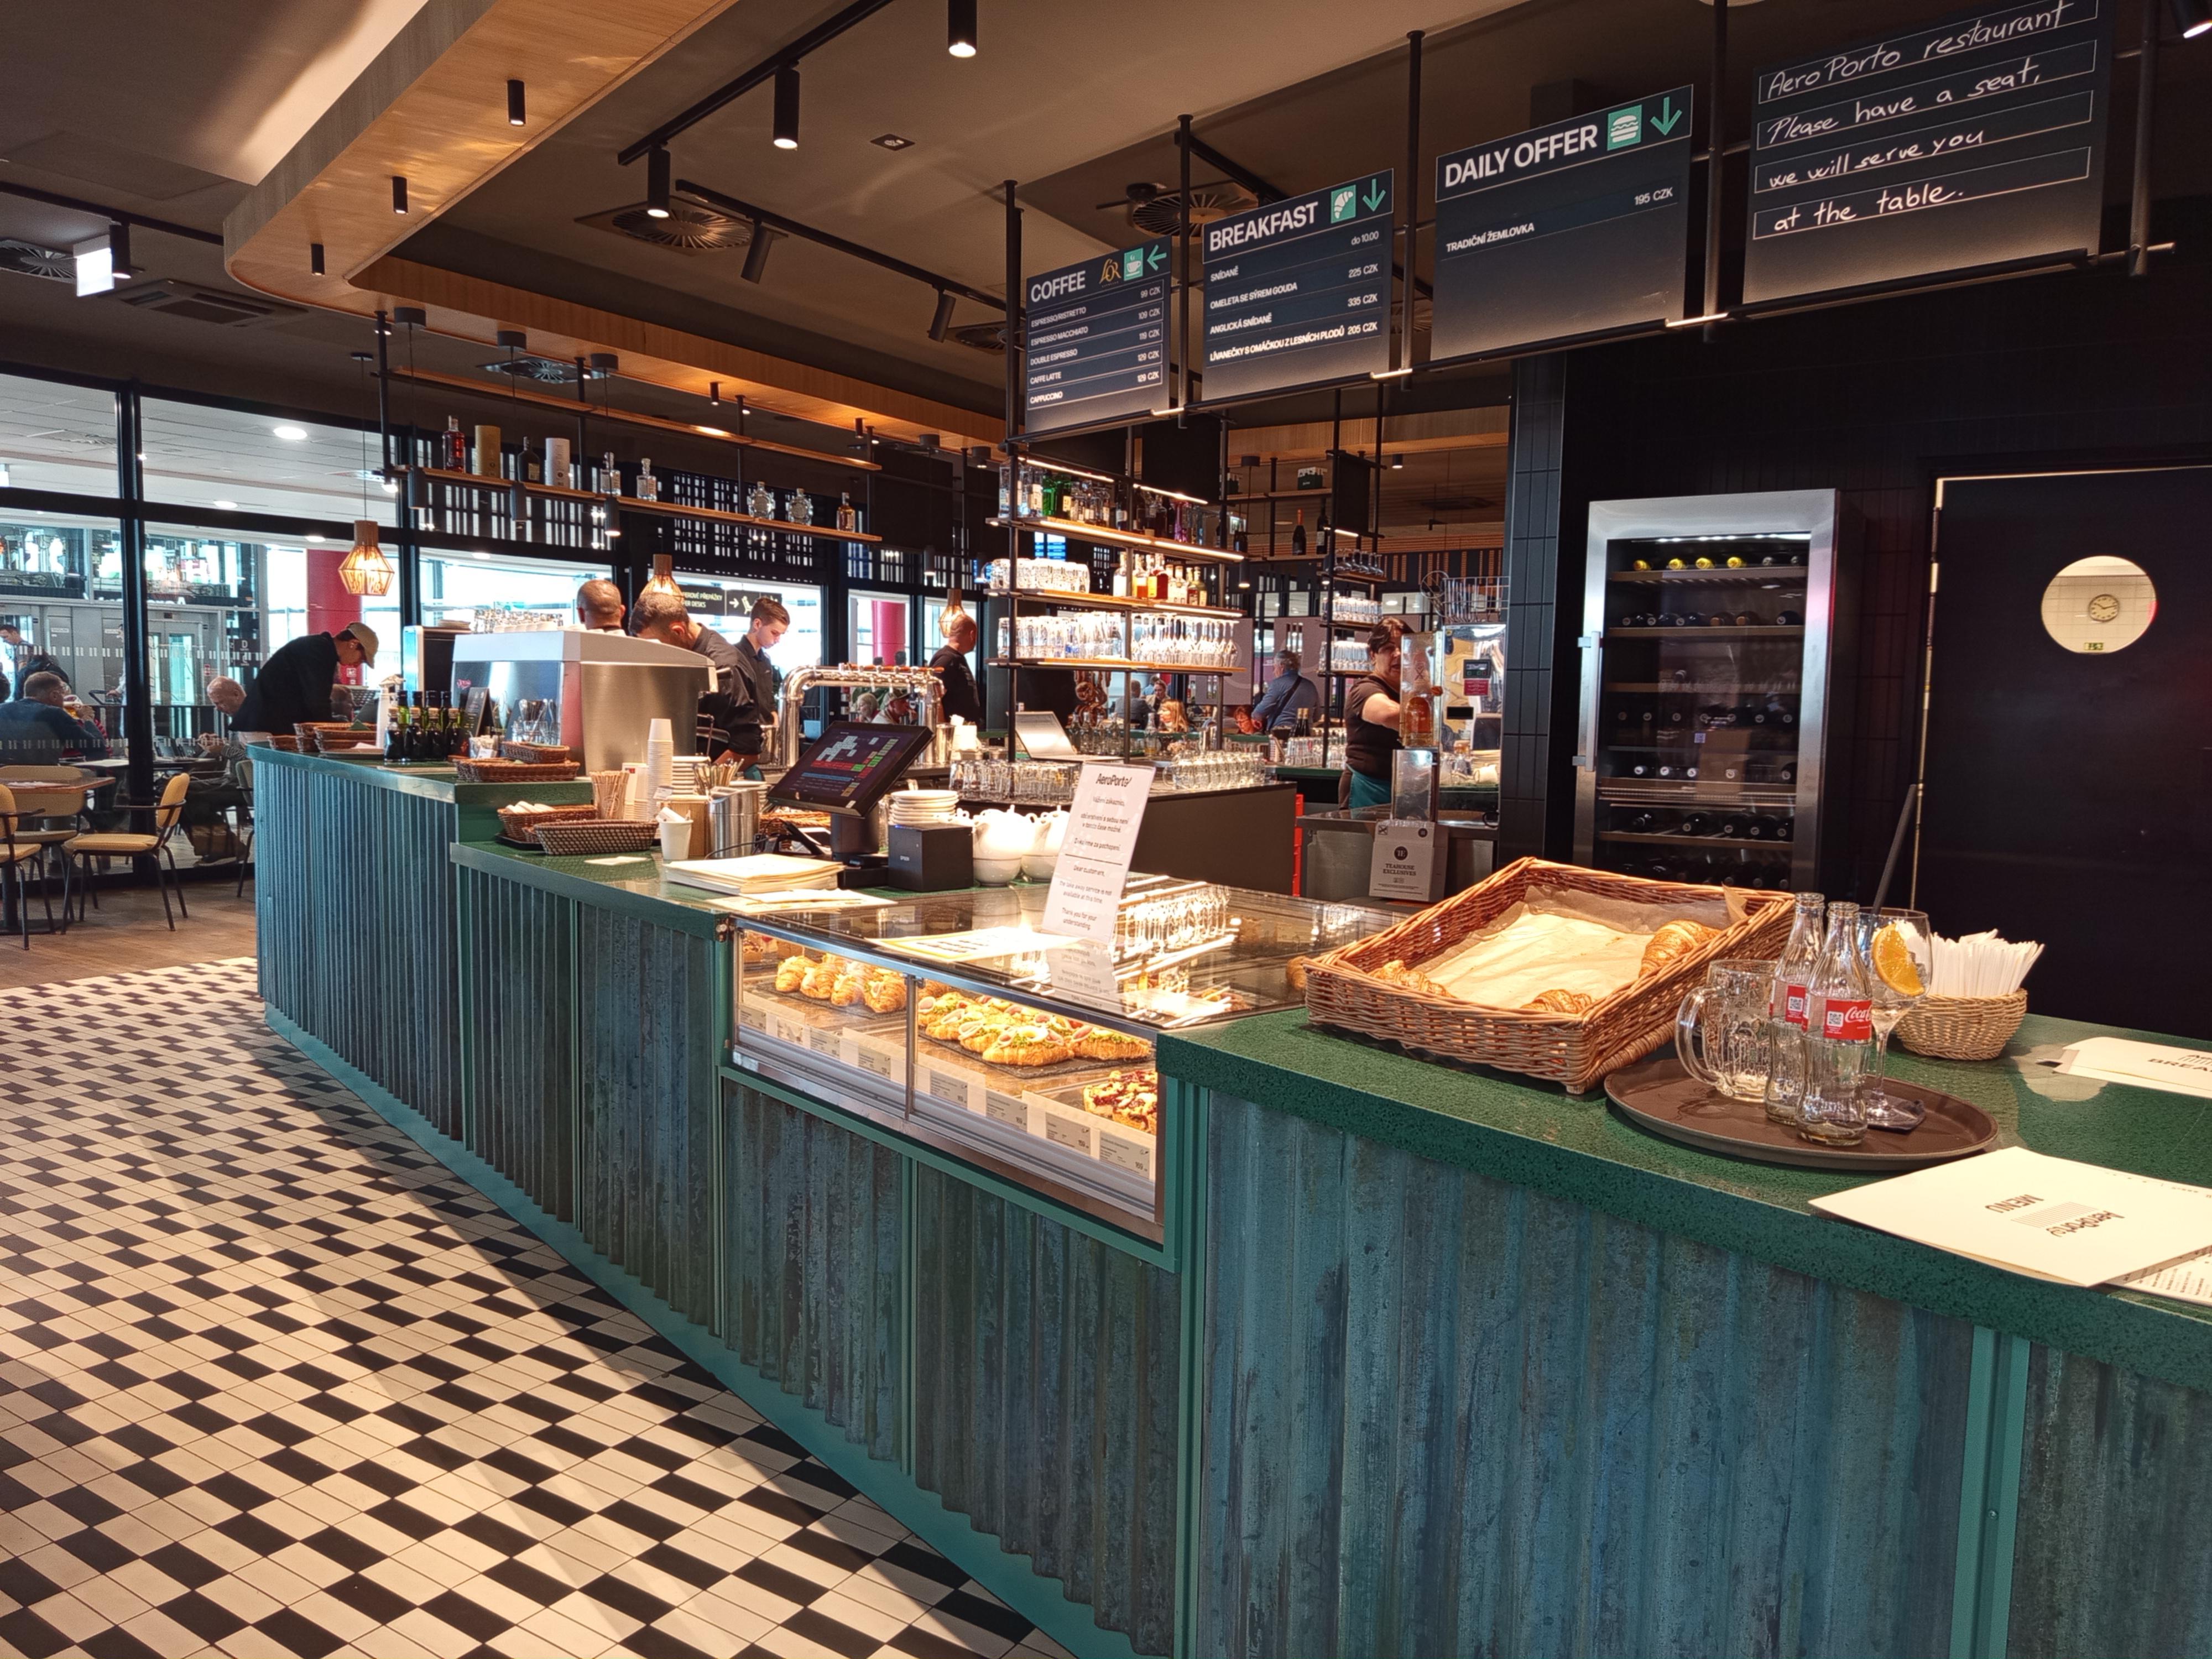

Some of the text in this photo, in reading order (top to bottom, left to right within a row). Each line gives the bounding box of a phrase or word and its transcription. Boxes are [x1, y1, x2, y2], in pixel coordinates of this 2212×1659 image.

[1923, 0, 2075, 59] restaurant
[1768, 117, 1839, 144] Please
[1855, 96, 1917, 123] have
[1936, 88, 1953, 103] a
[1445, 124, 1598, 188] DAILY OFFER
[1770, 129, 1984, 187] we will serve you
[1634, 187, 1673, 206] 195 CZK
[1773, 185, 1964, 232] at the table.
[1210, 201, 1318, 252] BREAKFAST
[1351, 231, 1379, 246] do 10.00
[1446, 222, 1535, 253] TRADIČNÍ ŽEMLOVKA
[1211, 265, 1239, 281] SNÍDANĚ
[1348, 263, 1378, 278] 225 CZK
[1031, 270, 1086, 302] COFFEE
[1140, 286, 1161, 298] 99 CZK
[1210, 282, 1297, 309] OMELETA SE SÝREM GOUDA
[1348, 293, 1378, 307] 335 CZK
[1138, 308, 1161, 320] 109 CZK
[1210, 312, 1272, 335] ANGLICKÁ SNÍDANĚ
[1347, 322, 1378, 336] 205 CZK
[1031, 333, 1057, 346] ESPRESSO
[1148, 329, 1160, 338] CZK
[1209, 326, 1344, 362] LÍVANEČKY S OMÁČKOU Z LESNÍCH PLODŮ
[1030, 348, 1078, 366] DOUBLE ESPRESSO
[1147, 350, 1159, 359] CZK
[1030, 372, 1061, 384] CAFFE LATTE
[1147, 371, 1159, 380] CZK
[1030, 392, 1063, 404] CAPPUCCINO
[2147, 1058, 2212, 1072] BREA
[1985, 1194, 2044, 1213] MENU
